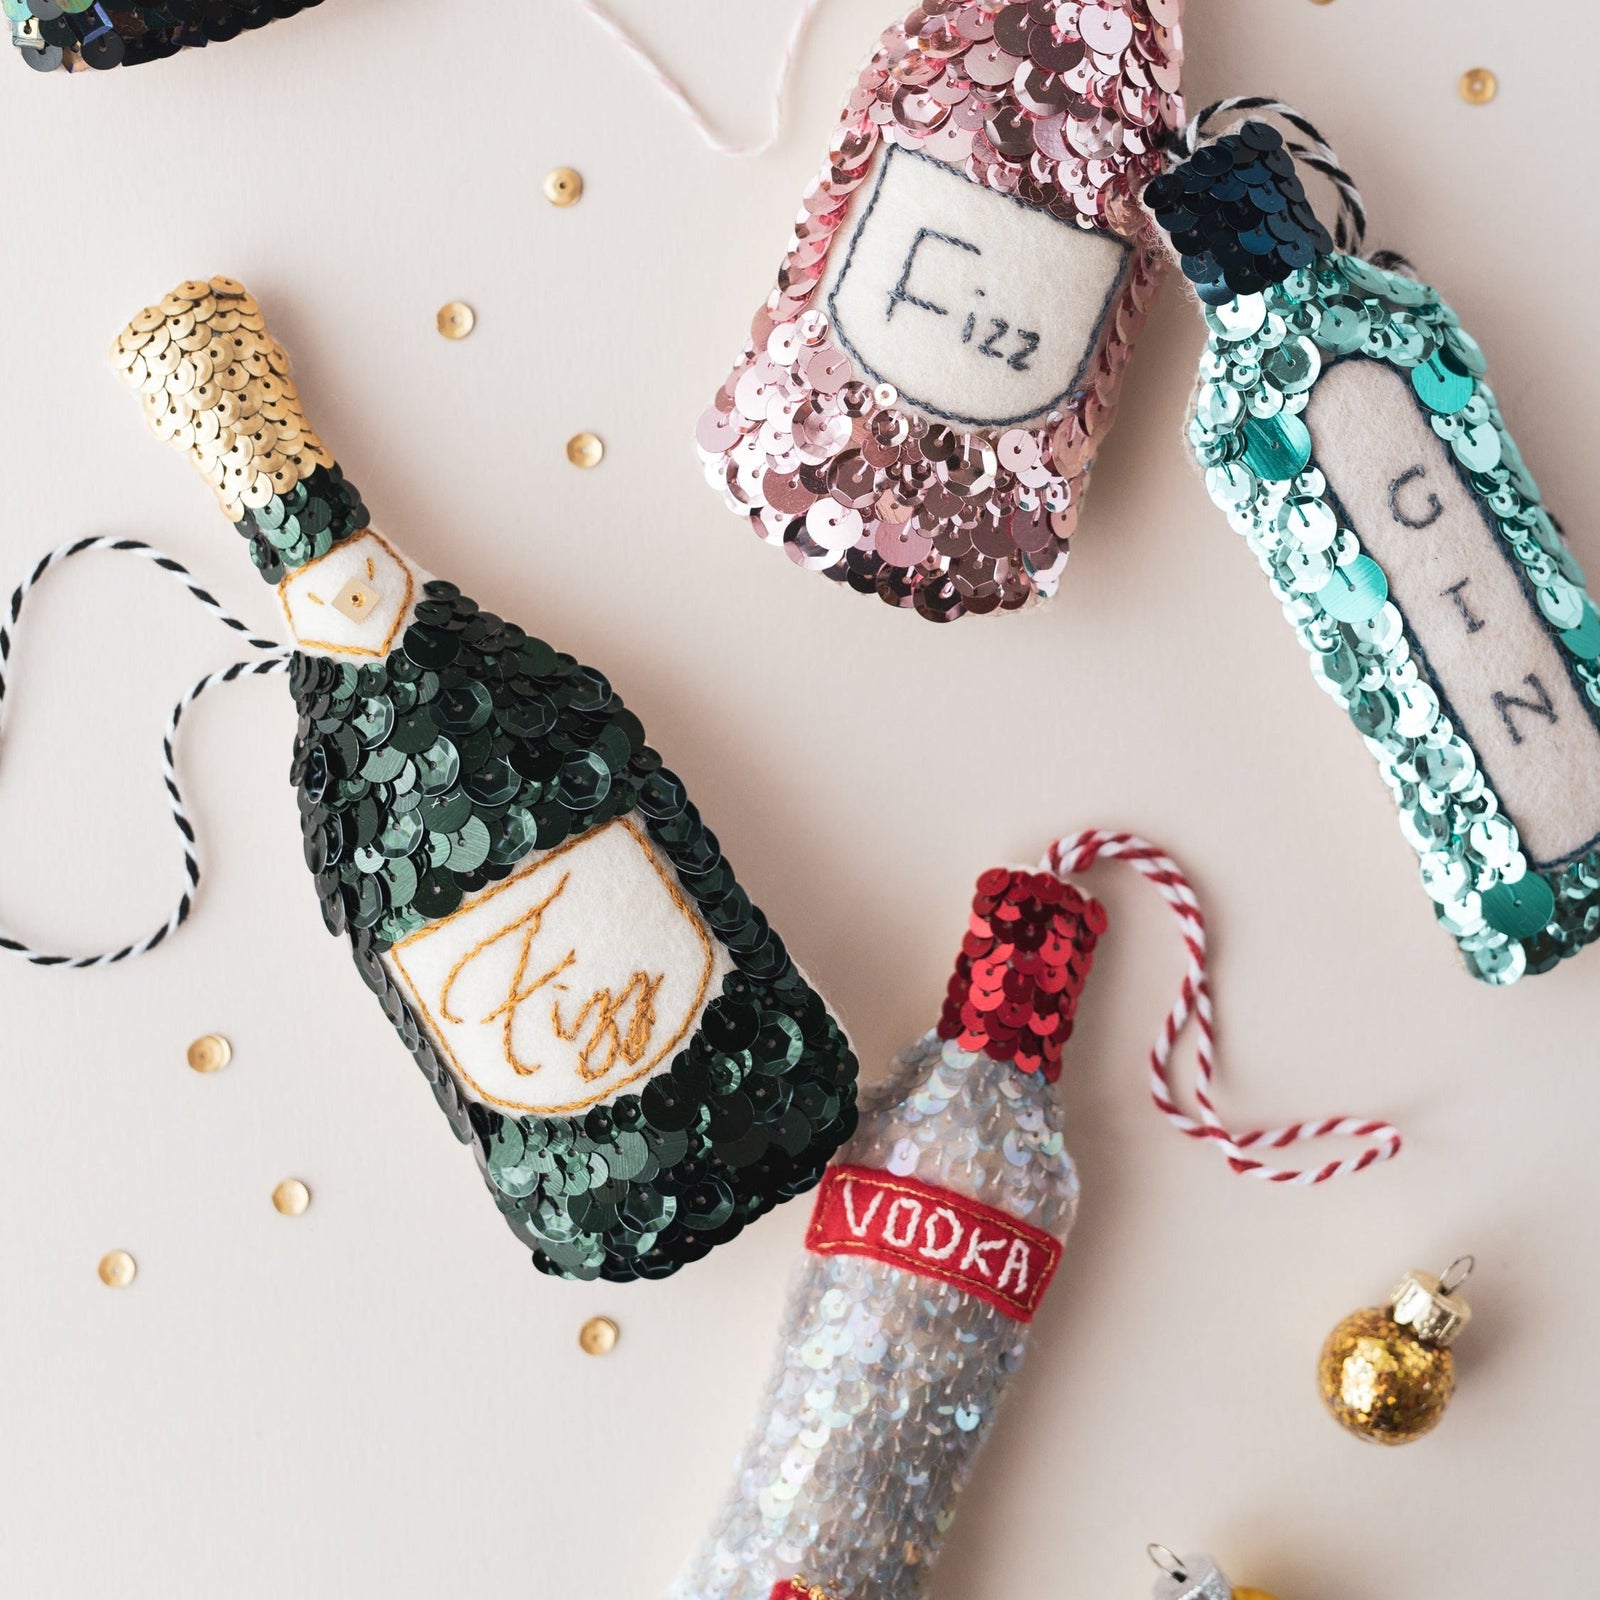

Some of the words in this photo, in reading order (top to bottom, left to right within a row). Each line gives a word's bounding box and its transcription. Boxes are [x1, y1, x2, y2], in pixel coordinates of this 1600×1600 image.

[886, 227, 1041, 372] Fizz
[1387, 463, 1559, 746] GIN
[842, 1181, 1030, 1295] VODKA
